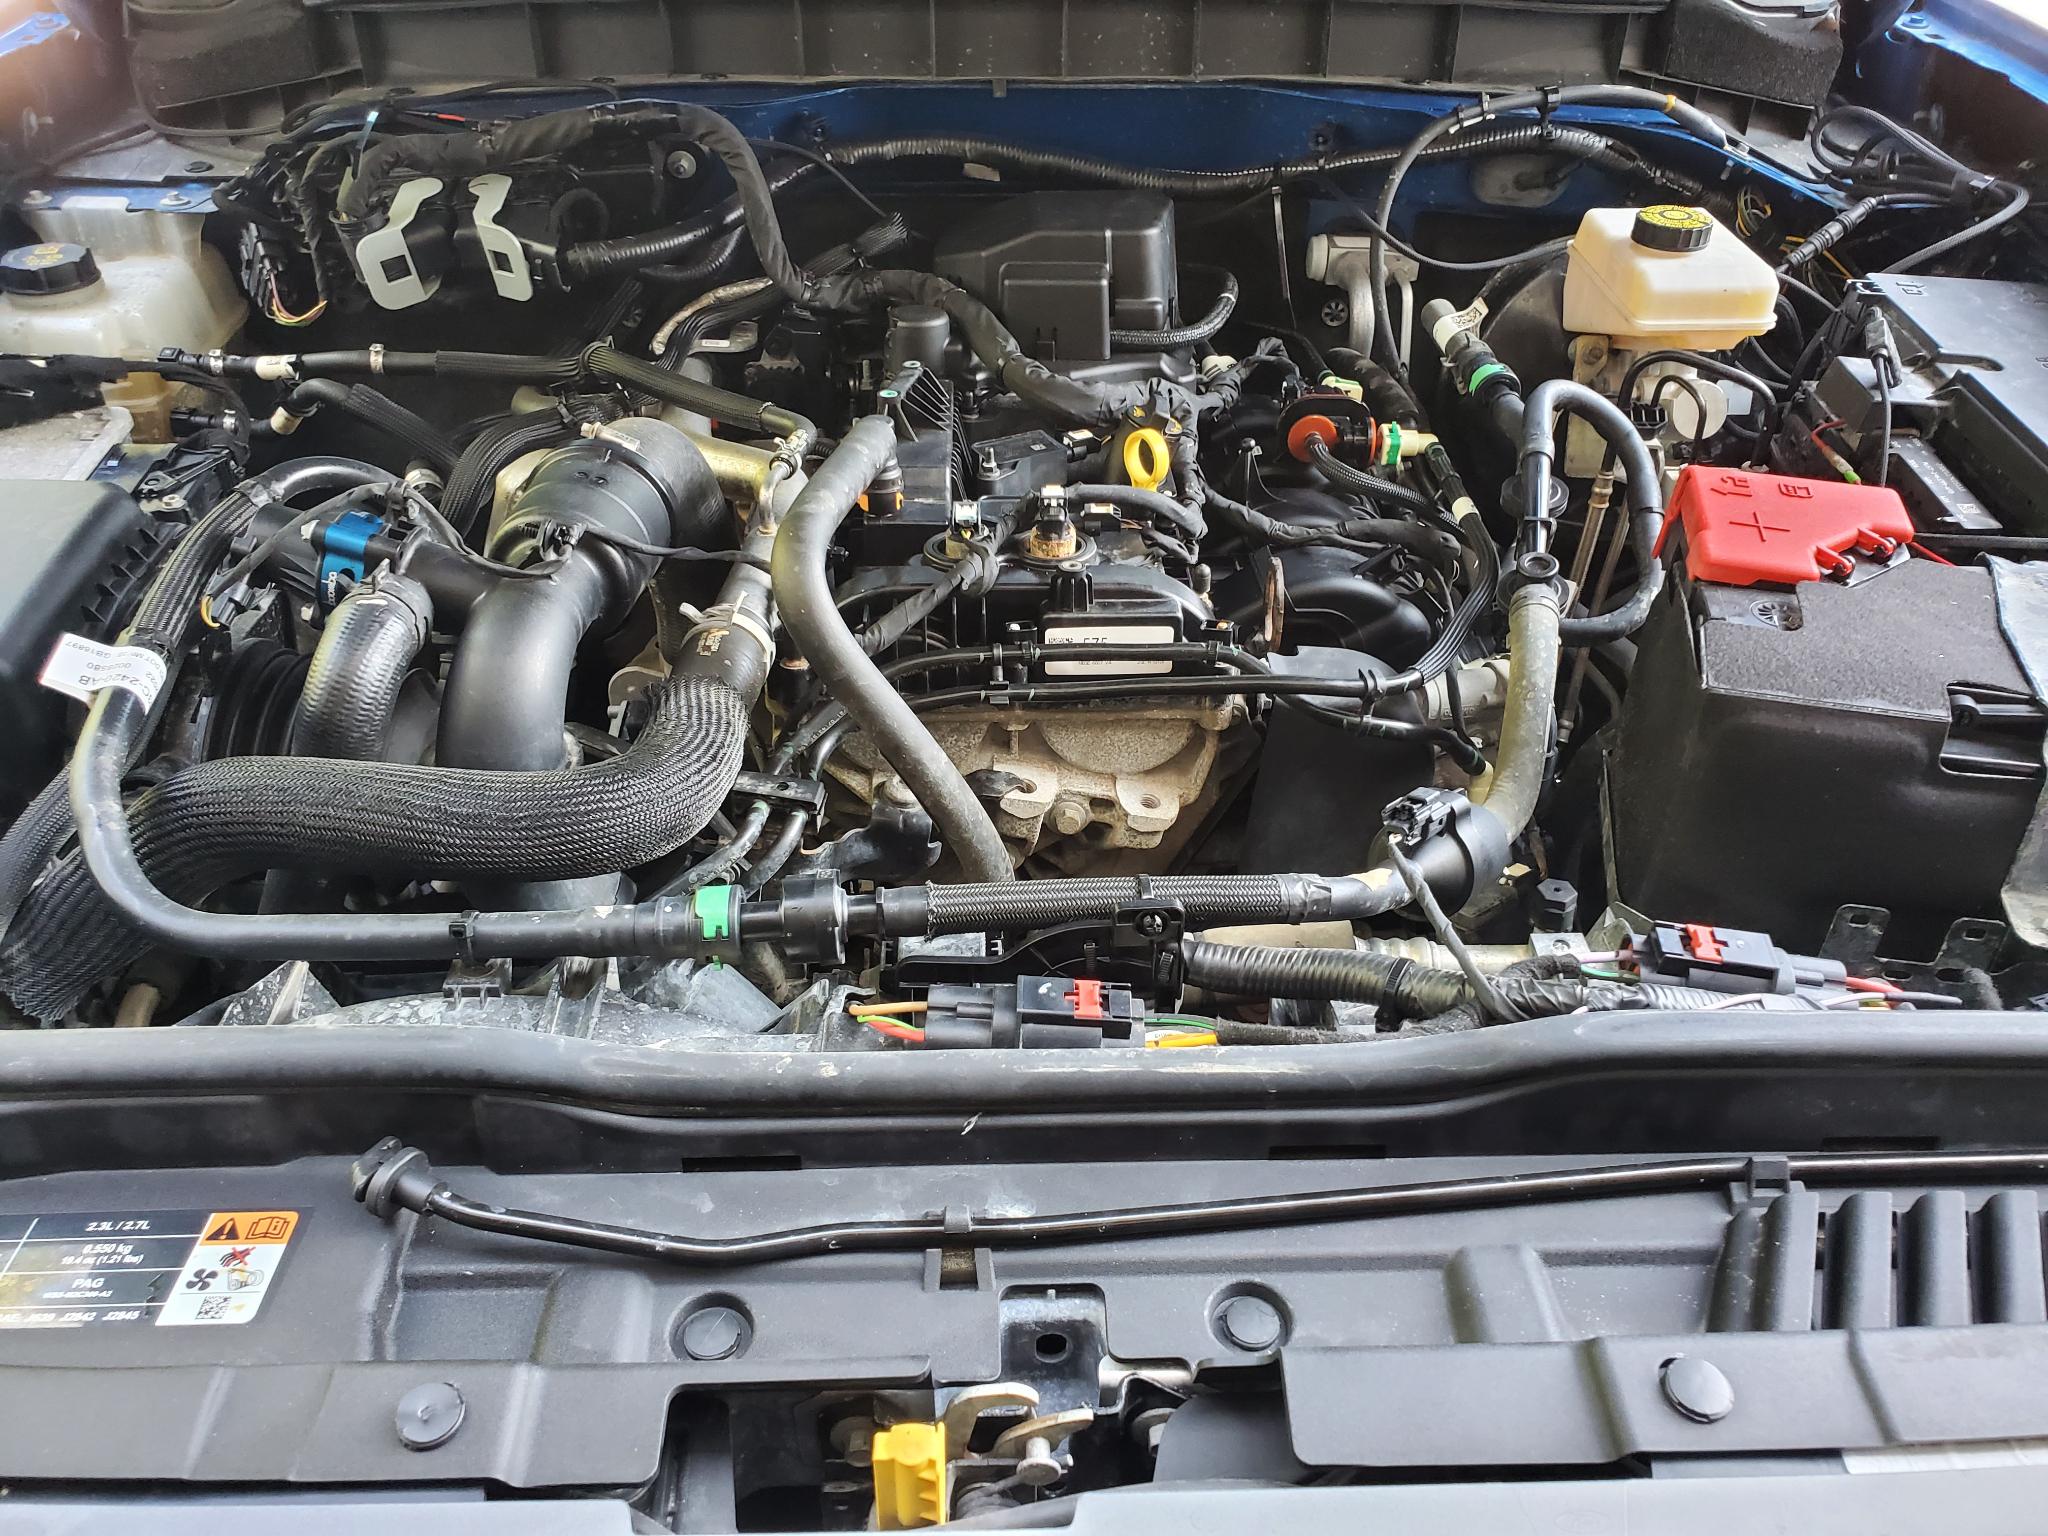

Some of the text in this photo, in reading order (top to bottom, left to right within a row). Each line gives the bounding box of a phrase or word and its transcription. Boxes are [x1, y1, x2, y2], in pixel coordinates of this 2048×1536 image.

[85, 1222, 113, 1232] 2.3L
[122, 1220, 151, 1232] 2.7L
[115, 1243, 134, 1255] kg
[71, 1278, 105, 1289] PAG
